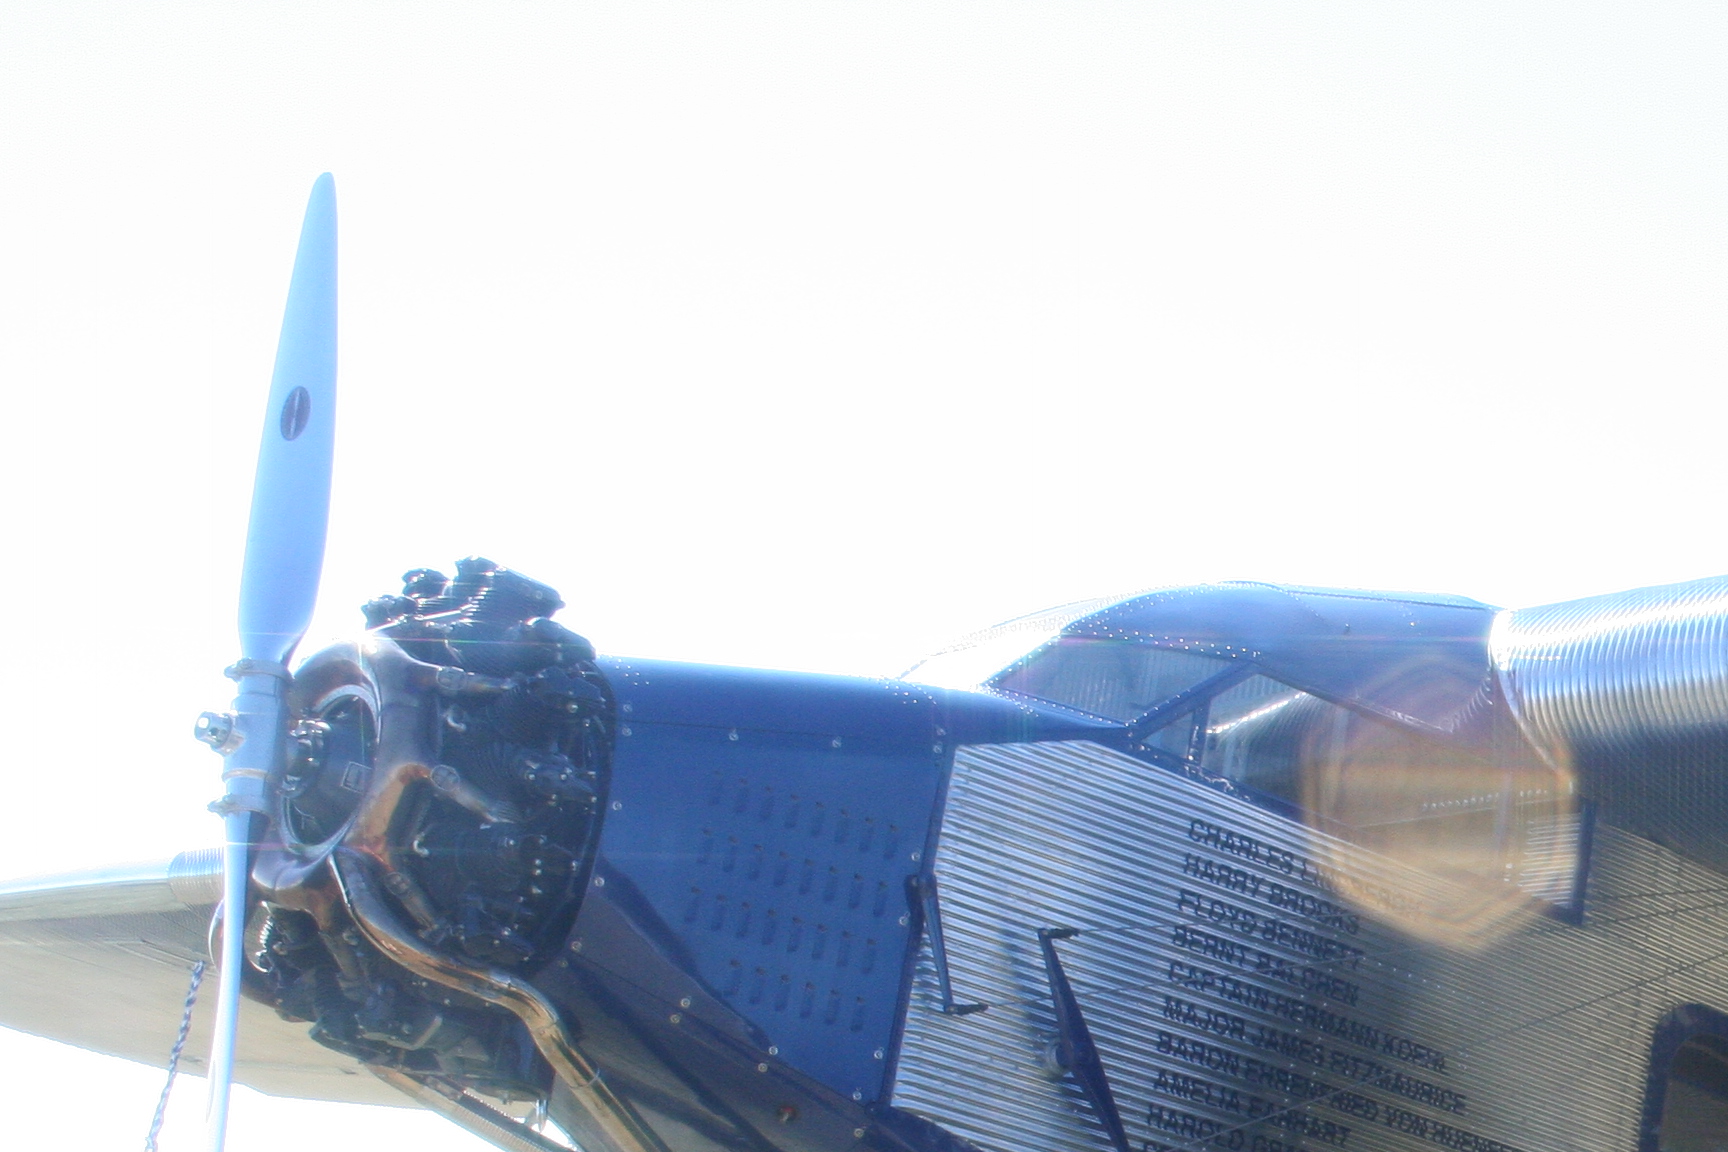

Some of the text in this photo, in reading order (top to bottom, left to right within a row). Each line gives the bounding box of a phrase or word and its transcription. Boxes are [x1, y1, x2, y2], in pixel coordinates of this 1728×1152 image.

[1188, 818, 1295, 875] CHARLES
[1178, 888, 1364, 972] FLOYD BENNETT
[1182, 852, 1360, 936] HARRY BROOKS
[1168, 960, 1271, 1011] CAPTAIN
[1273, 1000, 1380, 1051] HERMANN
[1172, 924, 1360, 1008] BERNT BALCHEN
[1156, 1031, 1241, 1077] BARON
[1384, 1103, 1428, 1140] VON
[1162, 996, 1467, 1118] MAJOR JAMES FITZMAURICE
[1146, 1105, 1245, 1150] HAROLD
[1153, 1070, 1351, 1149] AMELIA EARHART
